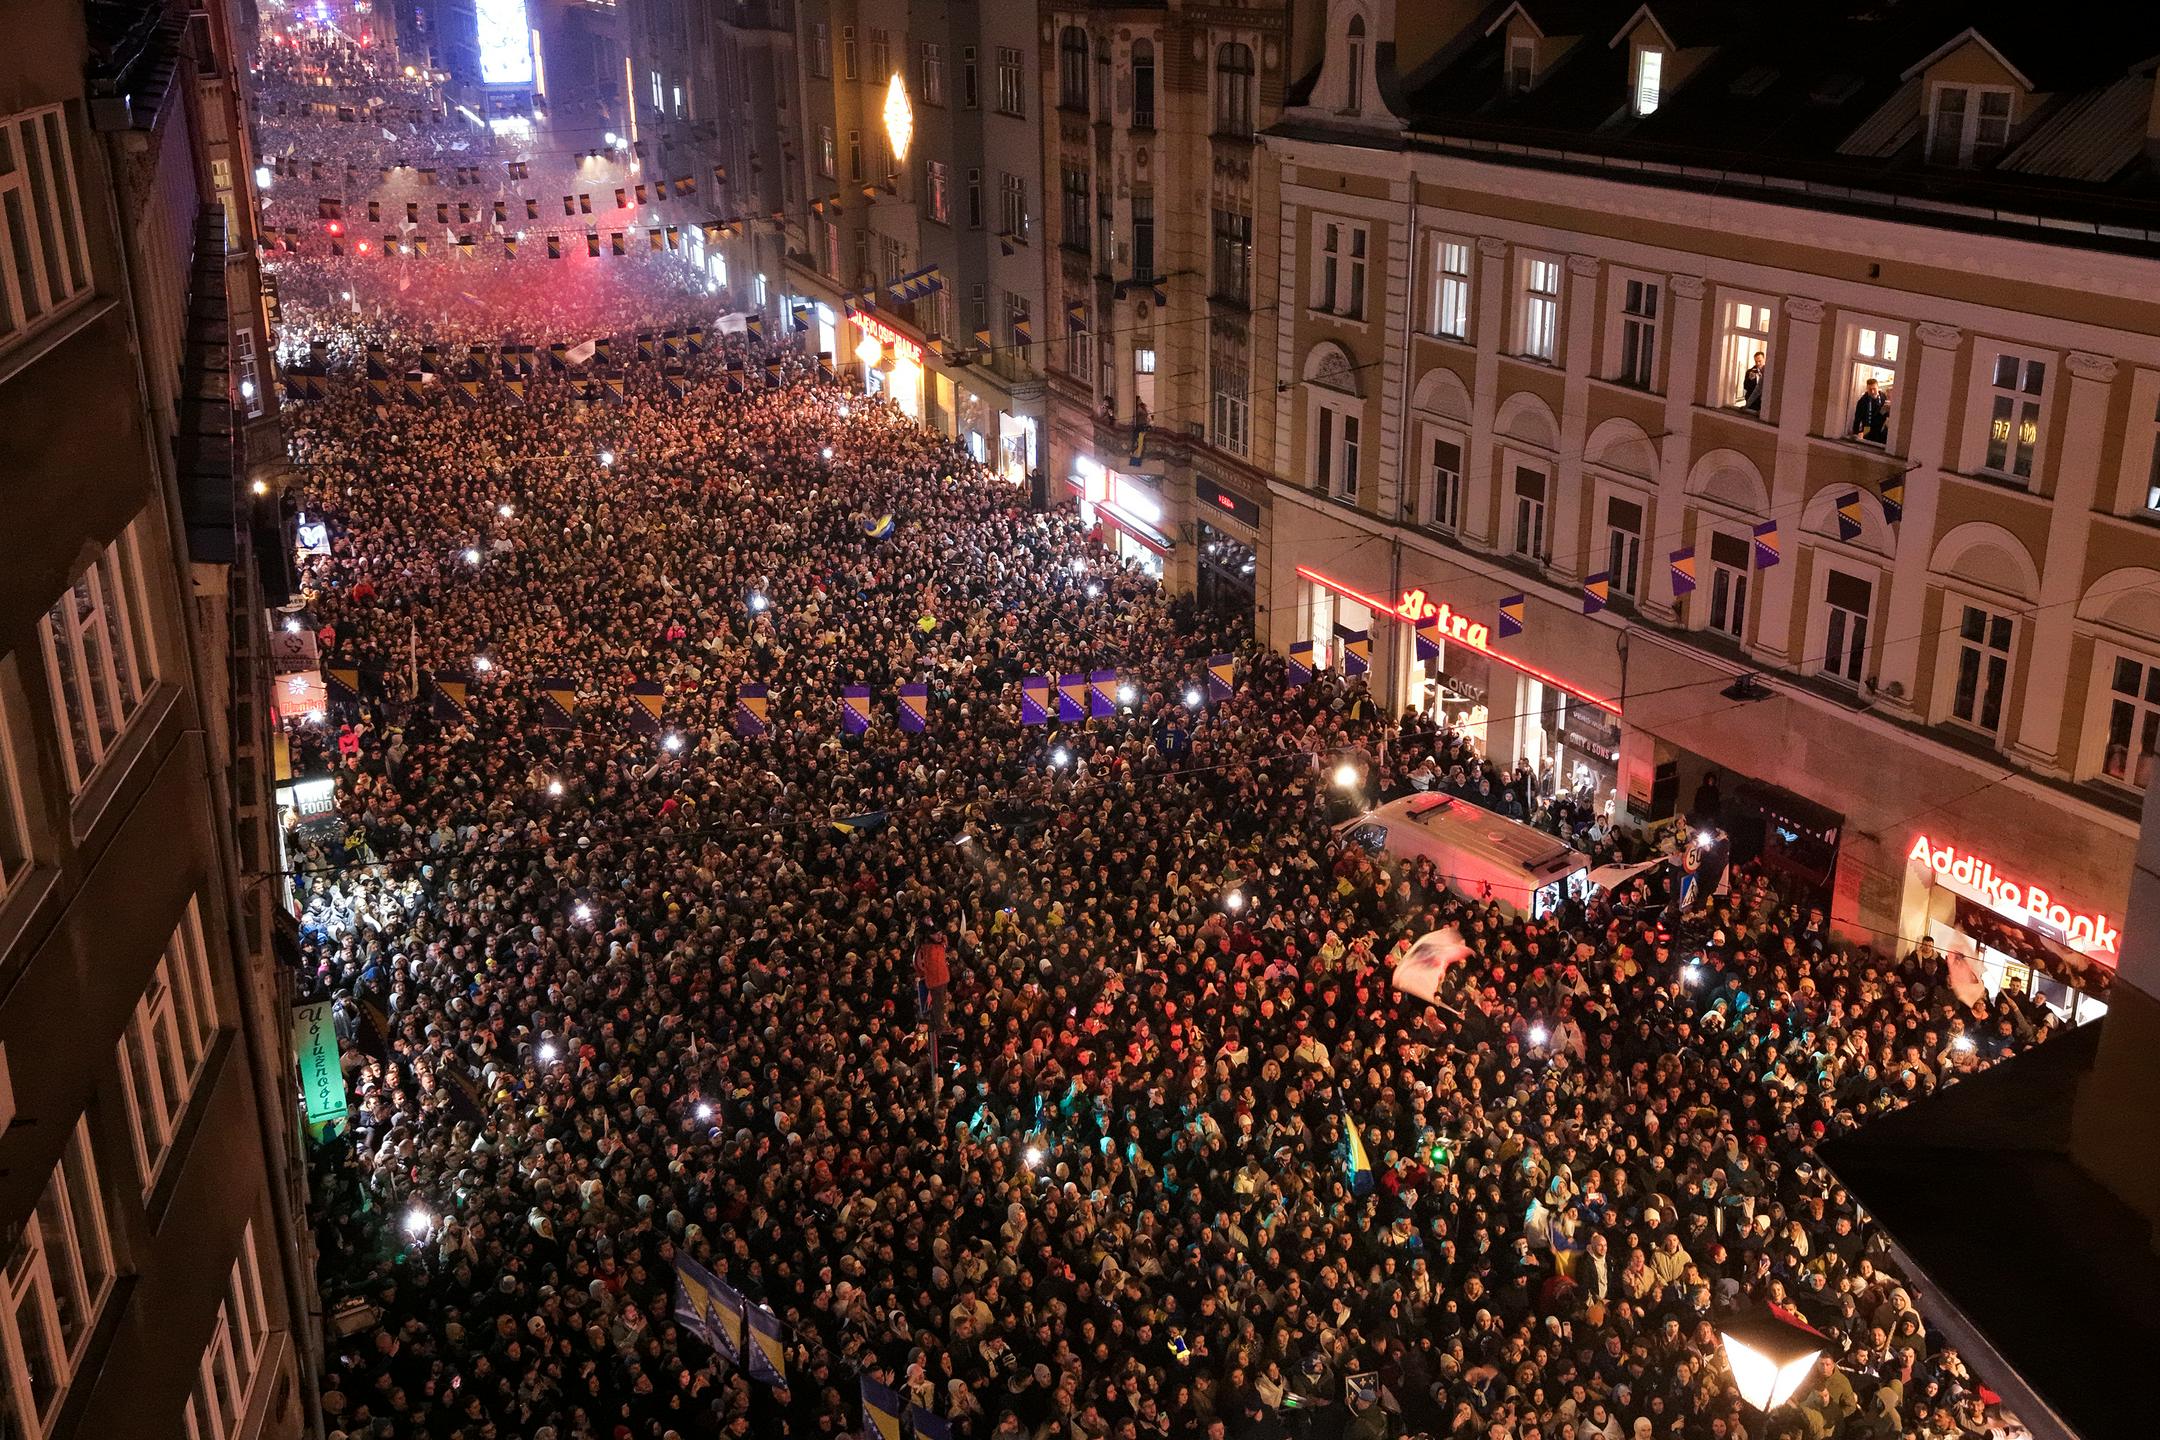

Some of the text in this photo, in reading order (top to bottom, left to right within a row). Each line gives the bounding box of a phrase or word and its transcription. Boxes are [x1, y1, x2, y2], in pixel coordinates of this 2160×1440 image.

[1397, 589, 1488, 649] Astra
[1449, 678, 1485, 700] ONLY
[1592, 743, 1610, 760] SONS
[301, 800, 333, 815] FOOD
[1909, 835, 2117, 954] Addiko Bank
